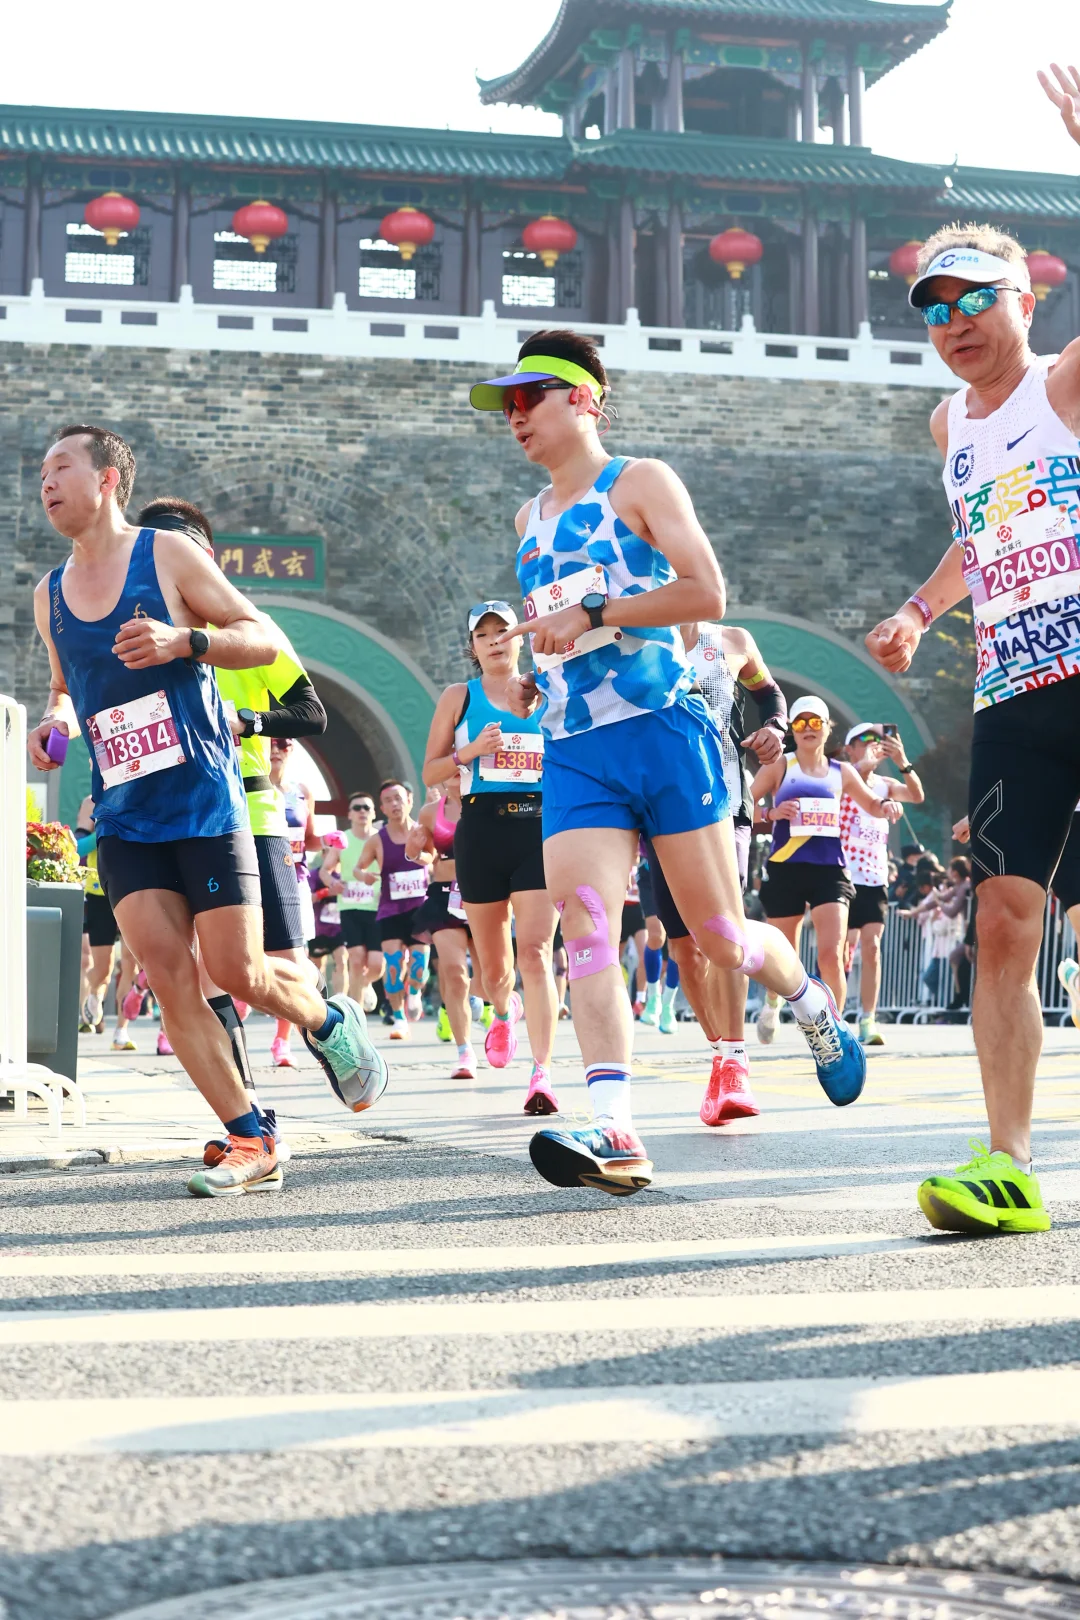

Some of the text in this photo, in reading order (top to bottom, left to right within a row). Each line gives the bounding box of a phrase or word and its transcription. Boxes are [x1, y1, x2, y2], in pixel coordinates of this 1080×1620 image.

[985, 541, 1070, 598] 26490
[526, 600, 535, 618] D
[107, 722, 172, 765] 13814
[496, 752, 543, 771] 53818
